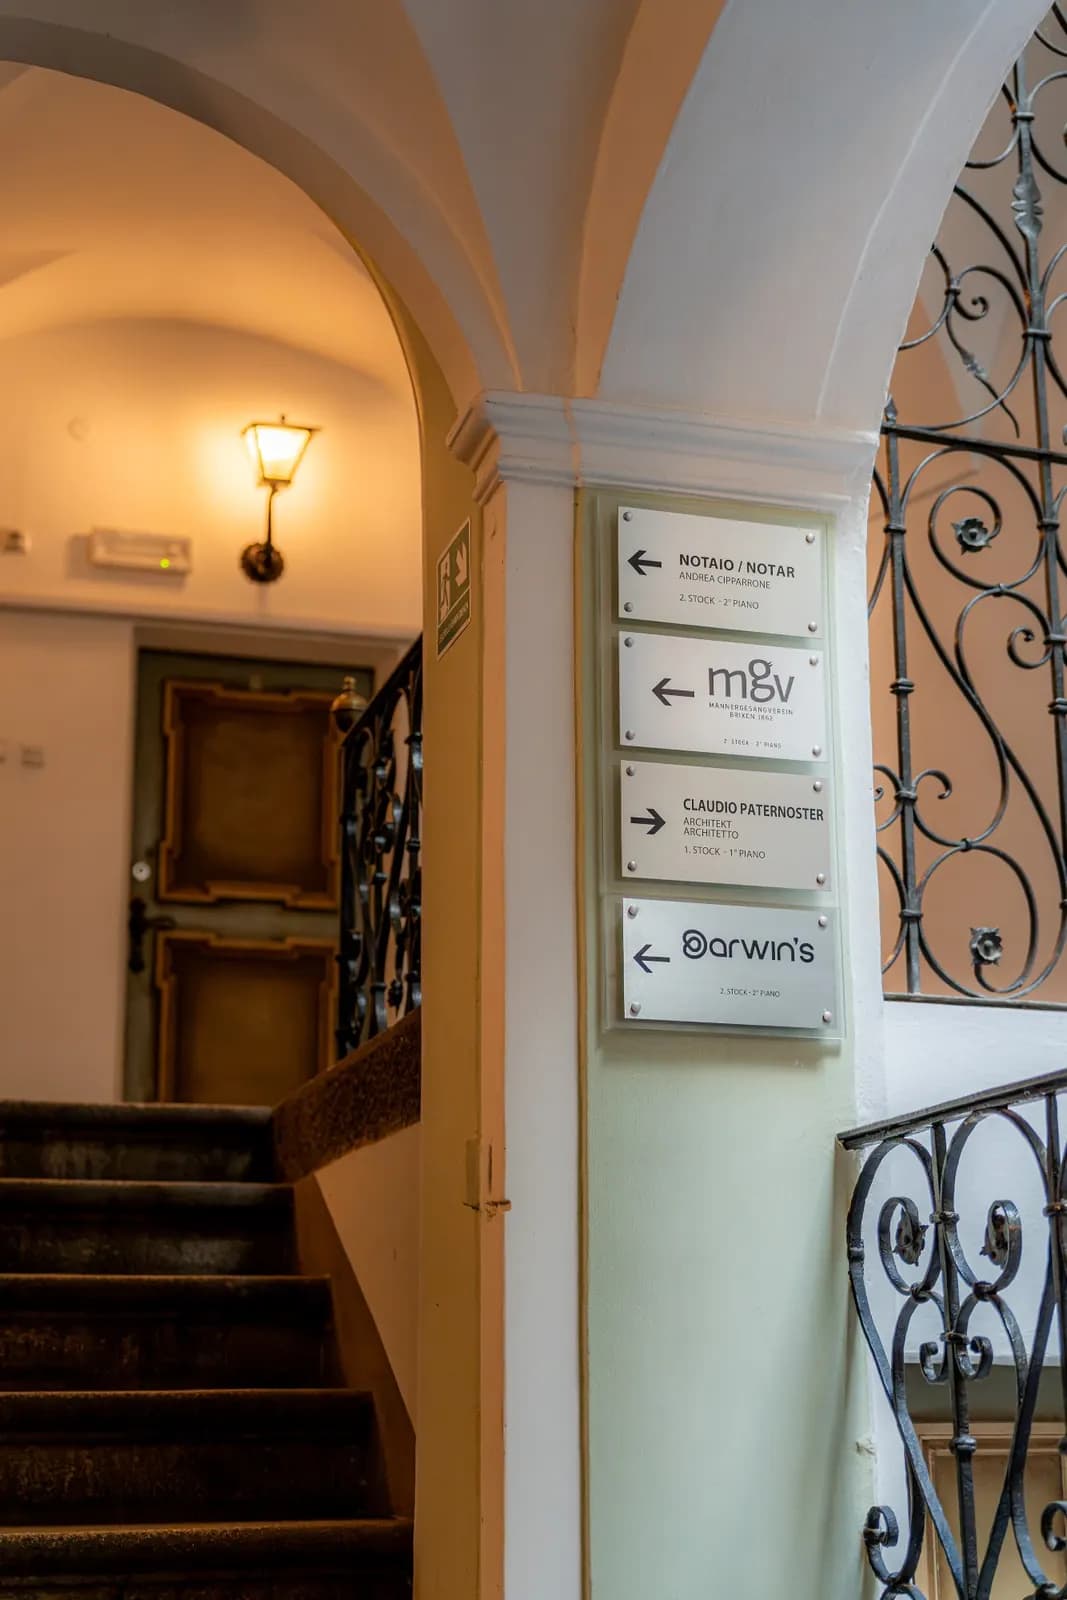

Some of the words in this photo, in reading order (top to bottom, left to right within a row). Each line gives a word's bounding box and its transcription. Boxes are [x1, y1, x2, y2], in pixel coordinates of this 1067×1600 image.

[679, 554, 734, 571] NOTAIO
[738, 561, 743, 573] /
[746, 561, 795, 578] NOTAR
[679, 571, 715, 583] ANDREA
[717, 575, 771, 589] CIPPARRONE
[688, 594, 715, 605] STOCK
[733, 599, 759, 610] PIANO
[708, 658, 796, 703] mgv
[683, 798, 738, 814] CLAUDIO
[740, 802, 824, 821] PATERNOSTER
[683, 817, 733, 829] ARCHITEKT
[683, 827, 739, 840] ARCHITETTO
[692, 846, 721, 856] STOCK
[739, 849, 766, 859] PIANO
[726, 988, 748, 996] STOCK
[760, 989, 780, 998] PIANO
